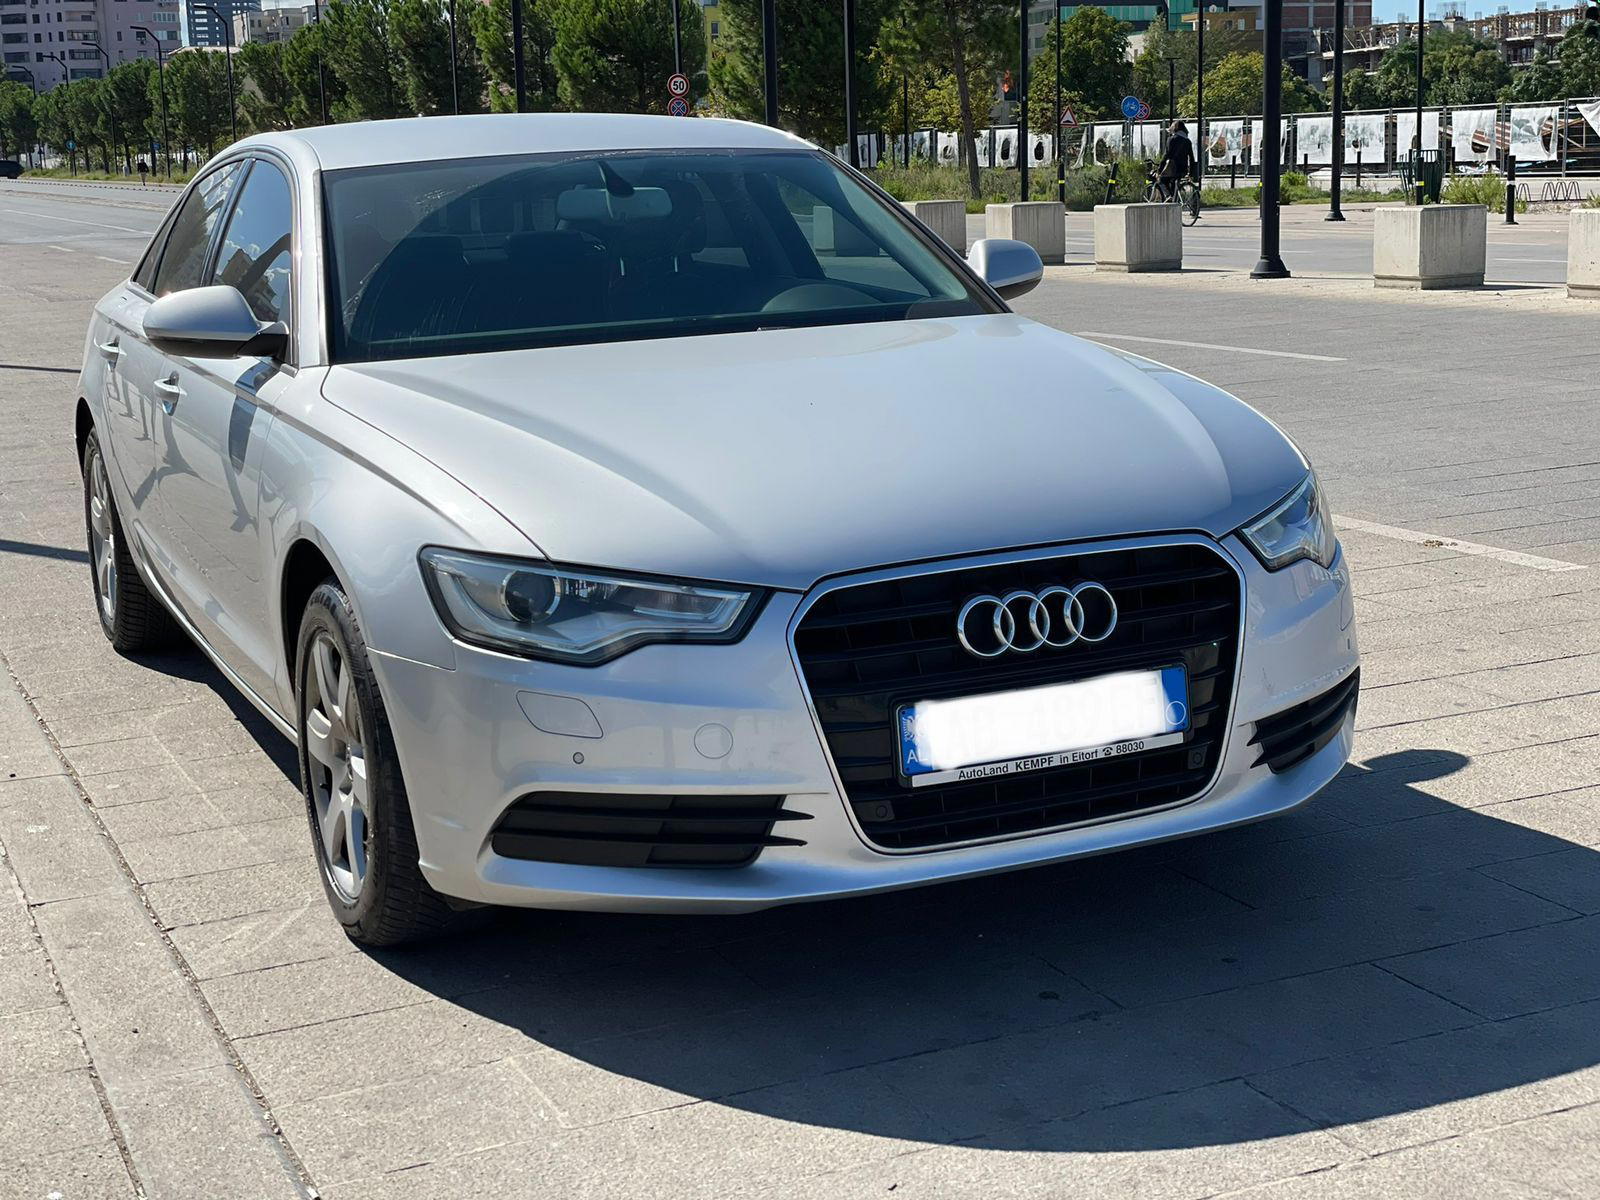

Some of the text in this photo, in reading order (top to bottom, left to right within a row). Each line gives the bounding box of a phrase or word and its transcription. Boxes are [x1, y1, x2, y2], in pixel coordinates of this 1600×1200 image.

[673, 81, 685, 91] 50
[958, 741, 1145, 780] AutoLand KEMPF in Eitorf 88030
